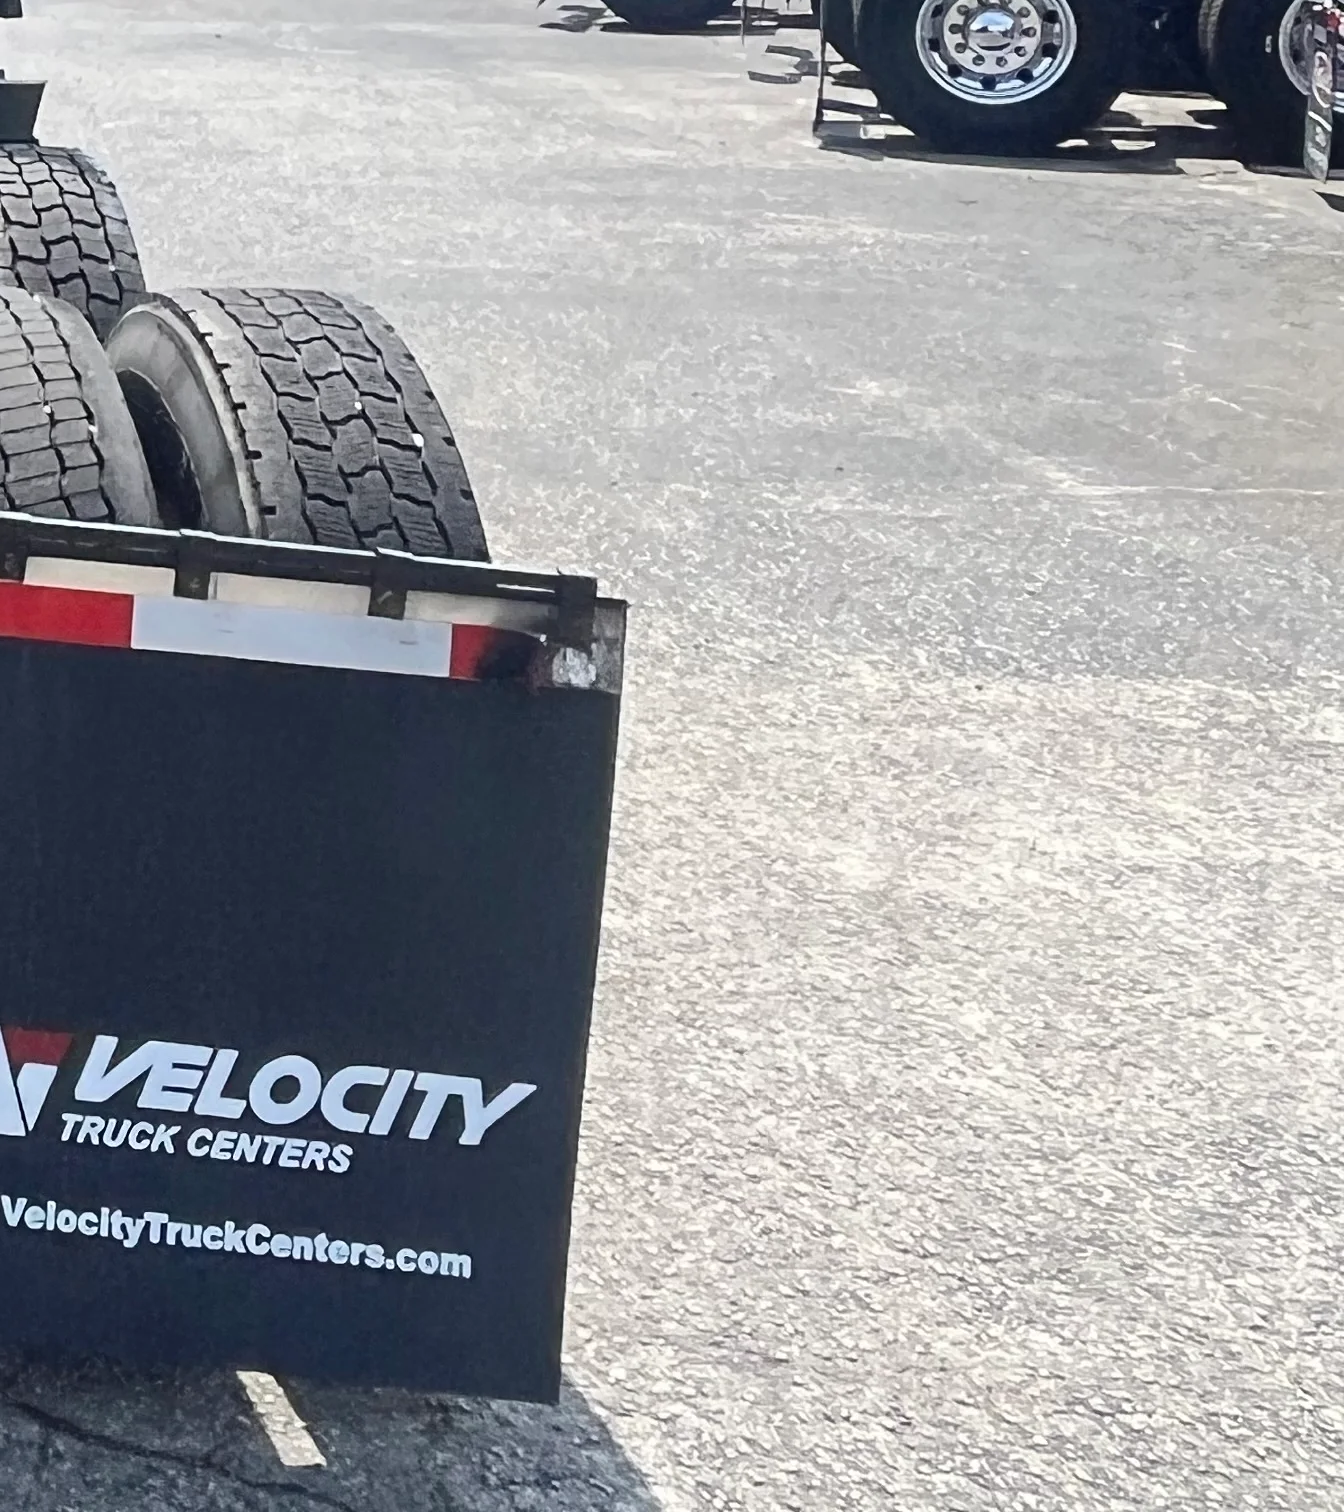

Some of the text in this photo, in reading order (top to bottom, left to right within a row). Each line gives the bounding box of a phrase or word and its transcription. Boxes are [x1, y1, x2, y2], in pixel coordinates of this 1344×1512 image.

[75, 1034, 537, 1146] VELOCITY
[60, 1112, 353, 1175] TRUCK CENTERS
[0, 1194, 472, 1280] VelocityTruckCenters.com
